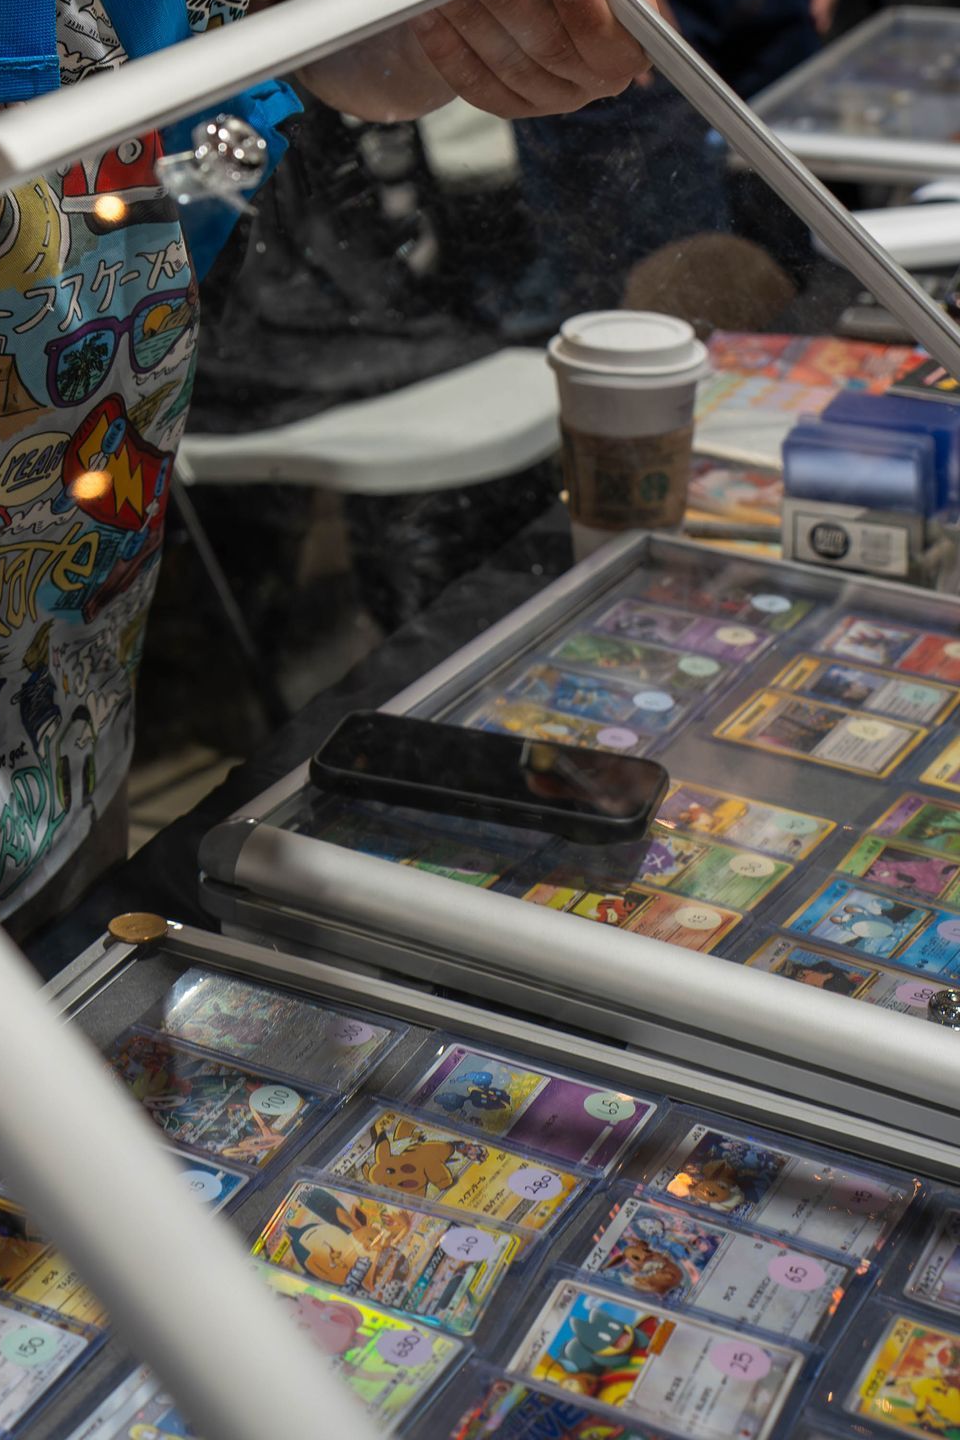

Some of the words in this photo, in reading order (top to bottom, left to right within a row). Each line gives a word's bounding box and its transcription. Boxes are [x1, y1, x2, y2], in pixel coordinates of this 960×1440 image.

[1, 440, 70, 486] YEAH
[260, 1090, 290, 1112] 900
[524, 1174, 553, 1196] 280
[457, 1236, 478, 1255] 210
[785, 1263, 808, 1285] 65
[16, 1335, 45, 1358] 150
[393, 1332, 420, 1358] 630
